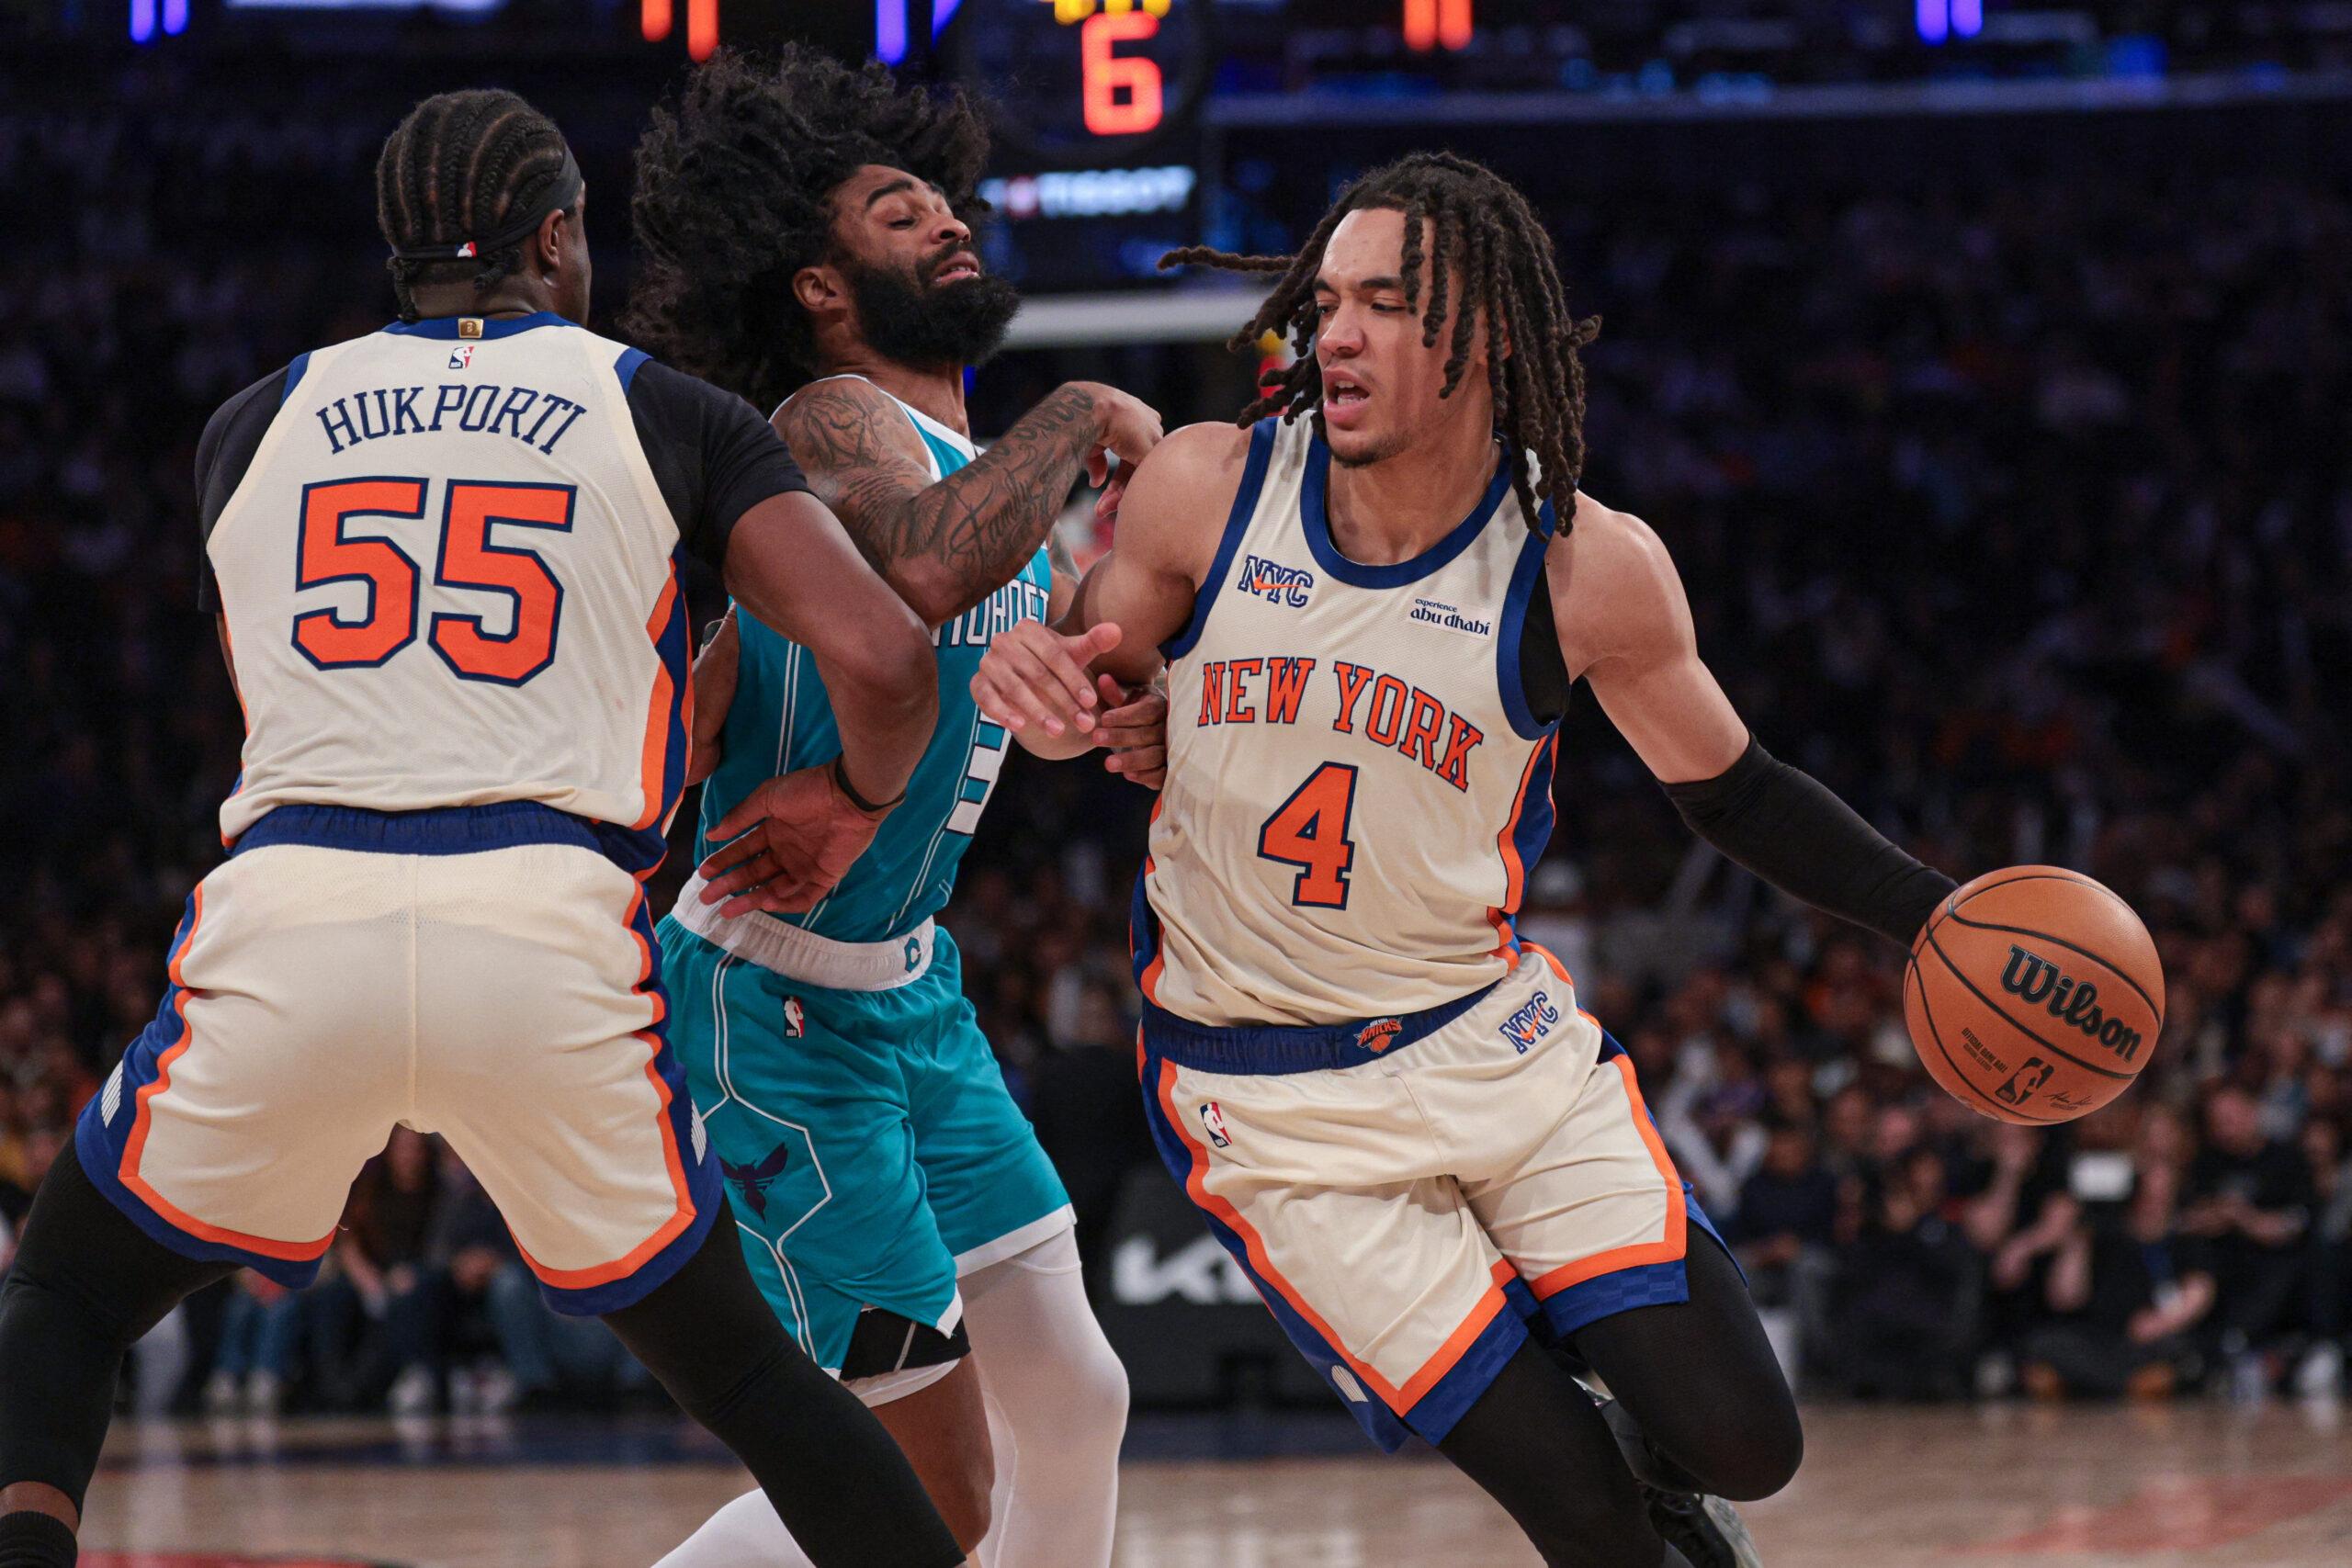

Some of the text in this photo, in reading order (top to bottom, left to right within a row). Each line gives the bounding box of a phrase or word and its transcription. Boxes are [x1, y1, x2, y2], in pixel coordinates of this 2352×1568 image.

[1081, 10, 1163, 136] 6
[315, 384, 587, 456] HUKPORTI
[290, 475, 578, 689] 55
[1238, 555, 1314, 608] NYC
[1415, 598, 1458, 613] experience
[1410, 607, 1491, 636] abu dhabi
[1197, 657, 1485, 794] NEW YORK
[1257, 761, 1359, 911] 4
[1357, 1018, 1403, 1047] KNICKS
[1498, 990, 1559, 1055] NYC
[2000, 943, 2143, 1063] Wilson
